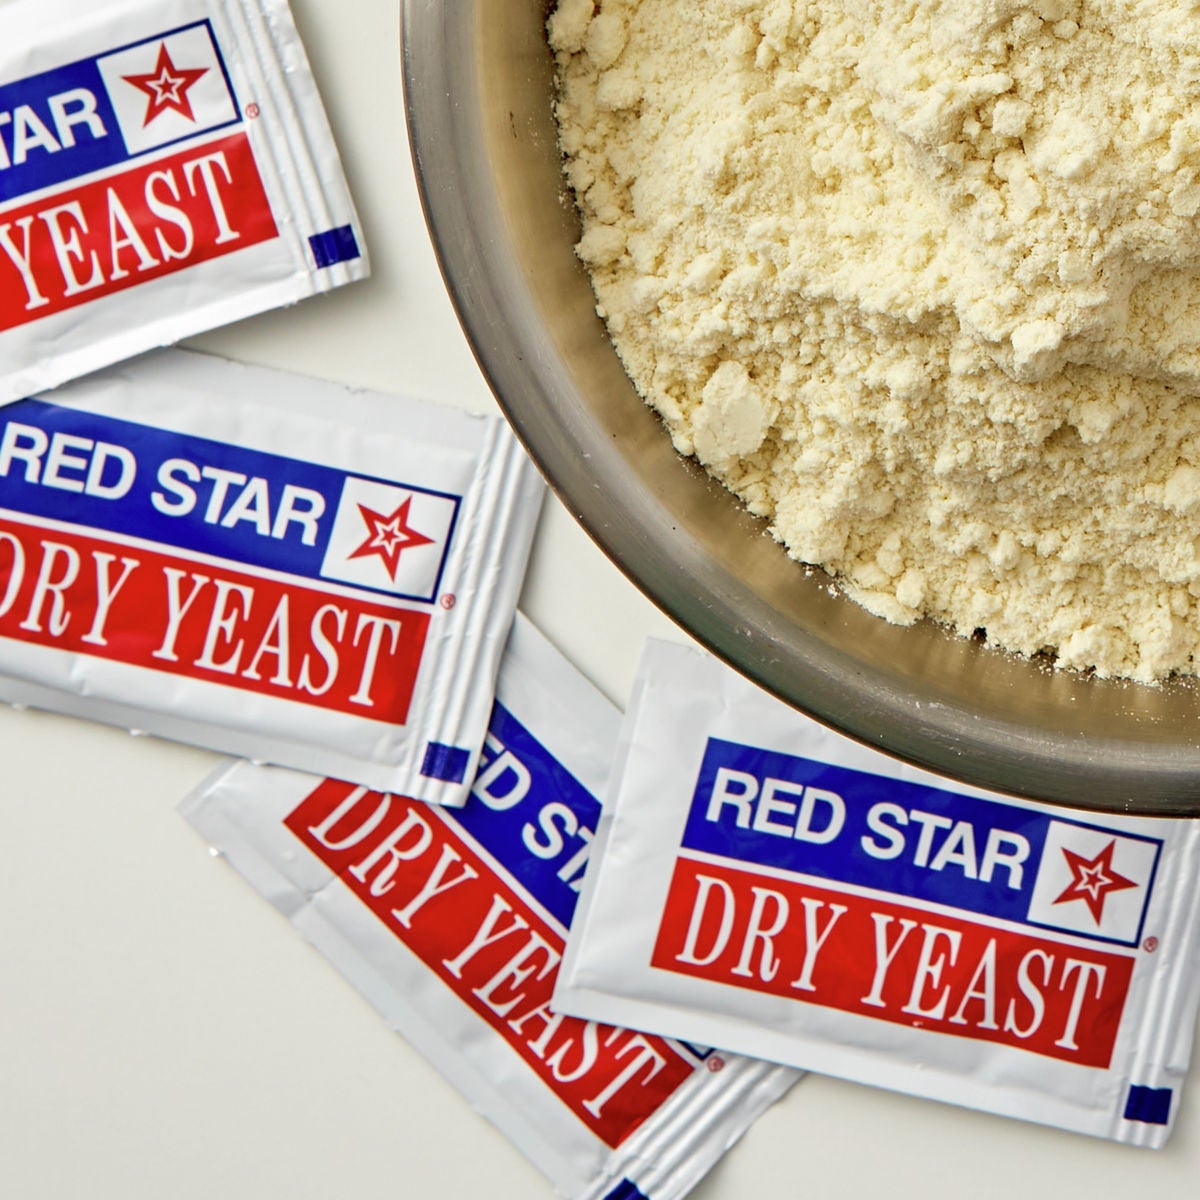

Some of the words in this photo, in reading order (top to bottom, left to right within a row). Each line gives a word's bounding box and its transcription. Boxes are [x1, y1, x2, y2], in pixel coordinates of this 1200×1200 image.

[0, 150, 240, 310] YEAST
[0, 421, 137, 500] RED
[151, 458, 327, 547] STAR
[152, 566, 401, 707] YEAST
[522, 801, 595, 894] ST
[706, 766, 846, 844] RED
[861, 802, 1031, 890] STAR
[306, 785, 479, 929] DRY
[442, 893, 667, 1118] YEAST
[675, 874, 848, 992] DRY
[860, 912, 1107, 1051] YEAST
